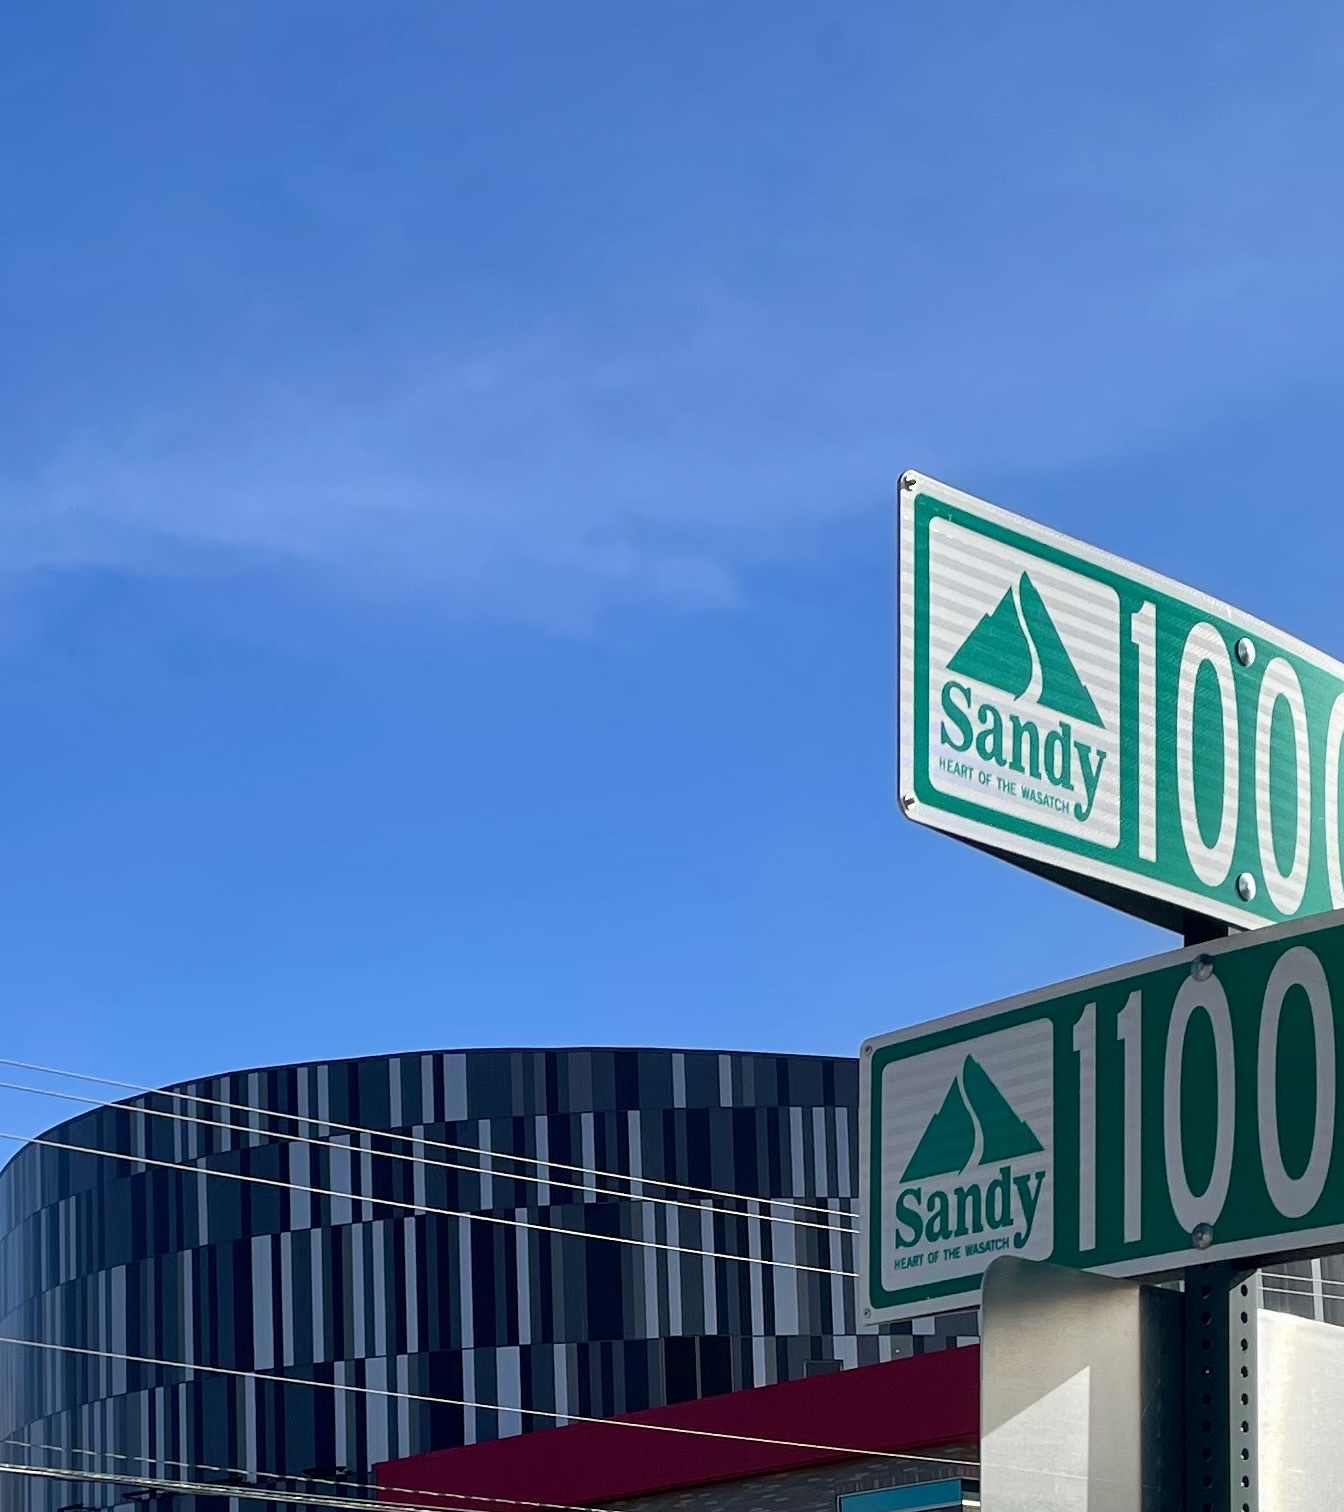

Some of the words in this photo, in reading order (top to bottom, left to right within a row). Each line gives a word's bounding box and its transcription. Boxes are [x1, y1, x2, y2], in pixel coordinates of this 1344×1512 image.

[939, 756, 974, 781] HEART
[978, 770, 992, 785] OF
[996, 777, 1017, 796] THE
[1020, 785, 1070, 814] WASATCH
[940, 680, 1107, 822] Sandy
[895, 1165, 1046, 1250] Sandy
[894, 1253, 924, 1270] HEART
[927, 1250, 940, 1264] OF
[944, 1246, 961, 1261] THE
[964, 1237, 1010, 1255] WASATCH
